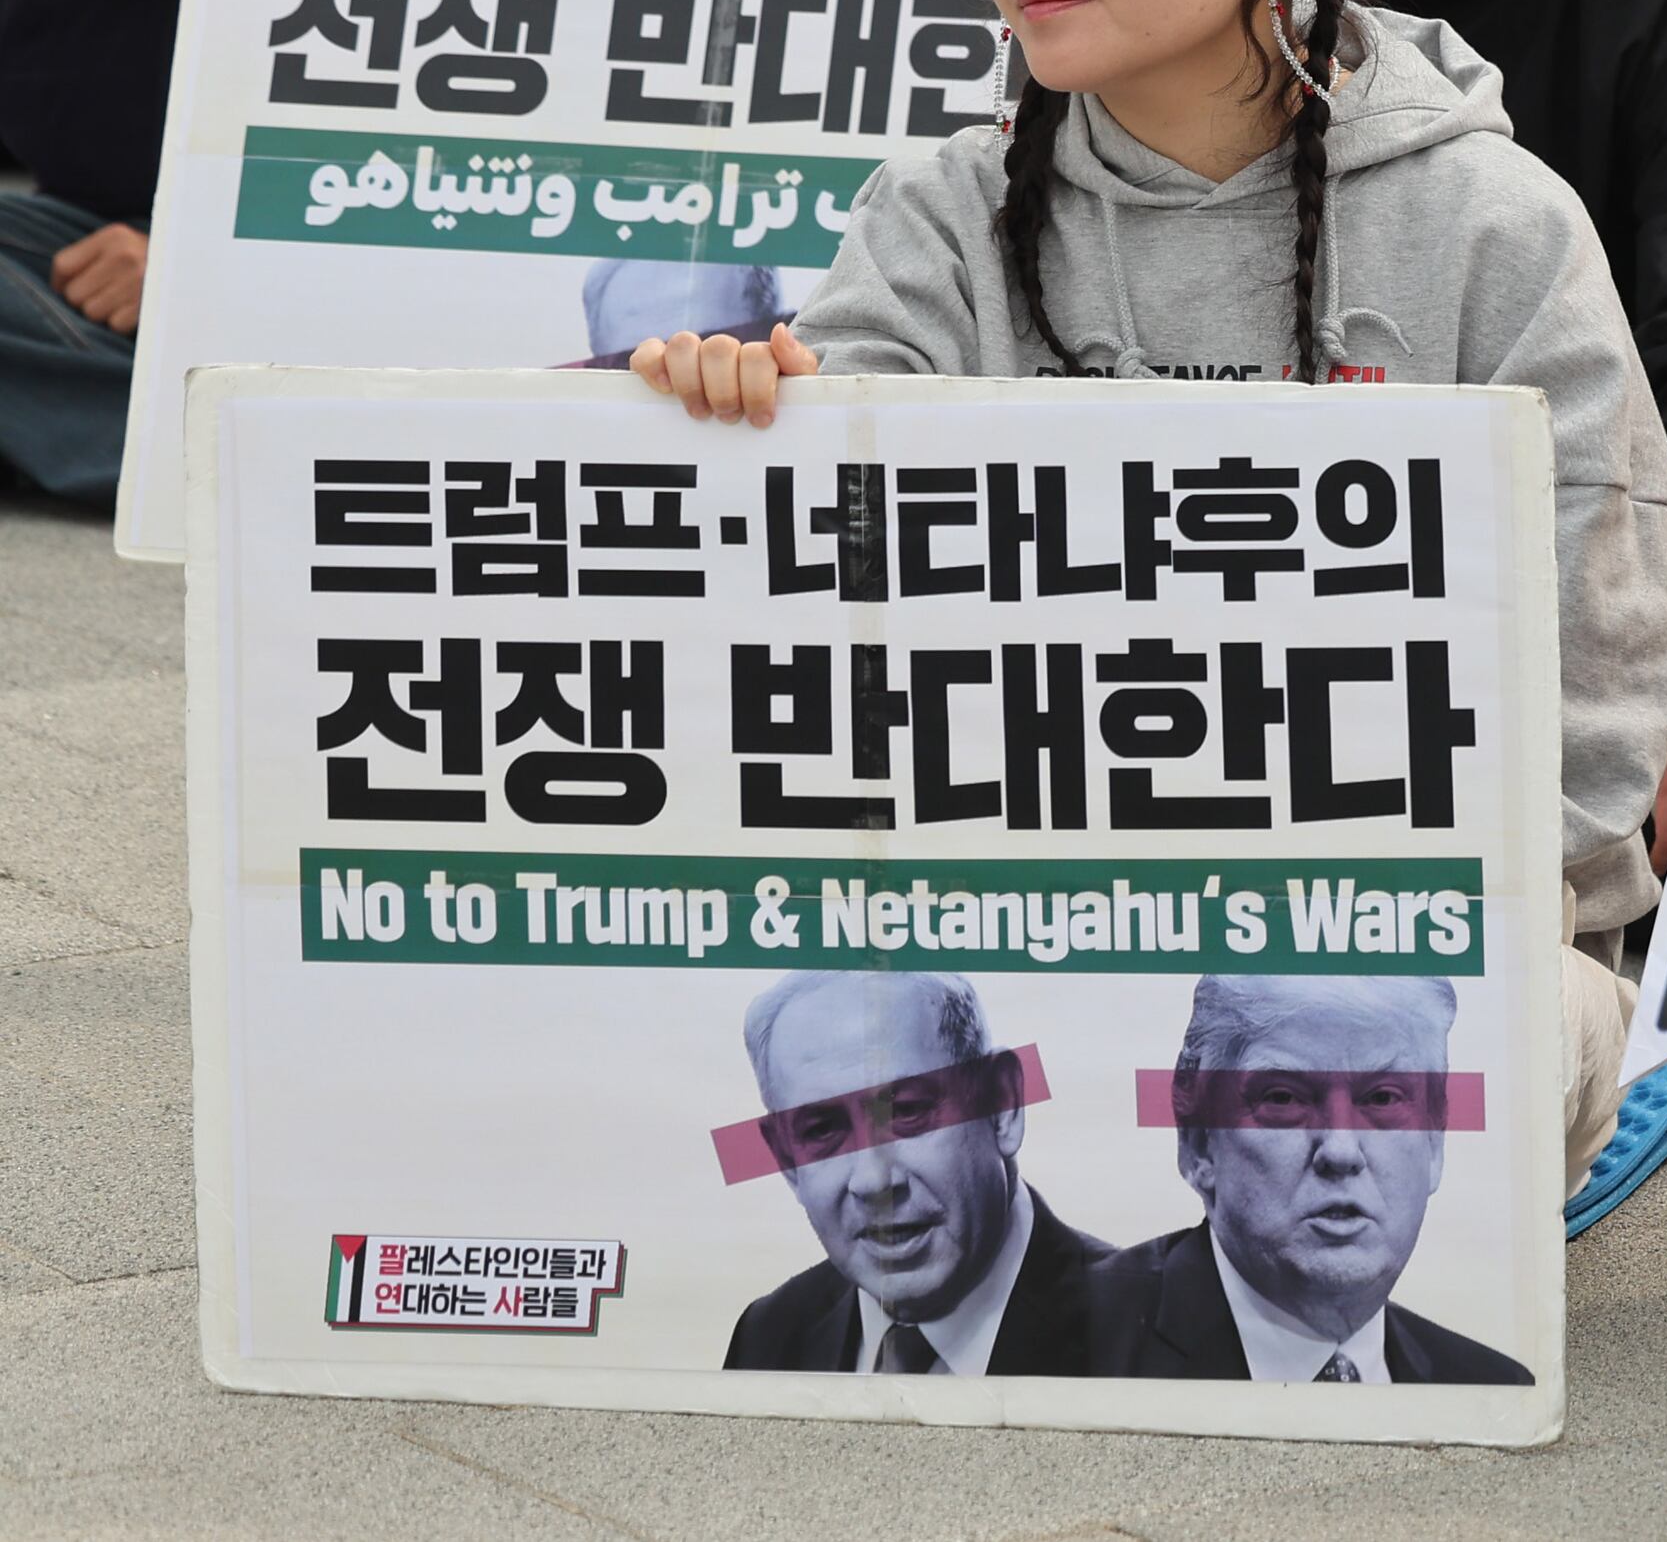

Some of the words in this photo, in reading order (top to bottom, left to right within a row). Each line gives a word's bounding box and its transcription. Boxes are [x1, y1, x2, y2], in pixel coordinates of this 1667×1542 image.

[305, 146, 576, 237] ونتنياهو
[594, 163, 803, 247] ترامب
[317, 638, 667, 825] 전쟁
[731, 639, 1475, 830] 반대한다
[321, 869, 405, 942] No
[424, 871, 496, 943] to
[516, 873, 728, 957] Trump
[751, 876, 800, 948] &
[1287, 879, 1472, 957] Wars
[374, 1283, 487, 1315] 연대하는
[493, 1286, 579, 1318] 사람들
[379, 1244, 606, 1280] 팔레스타인인들과
